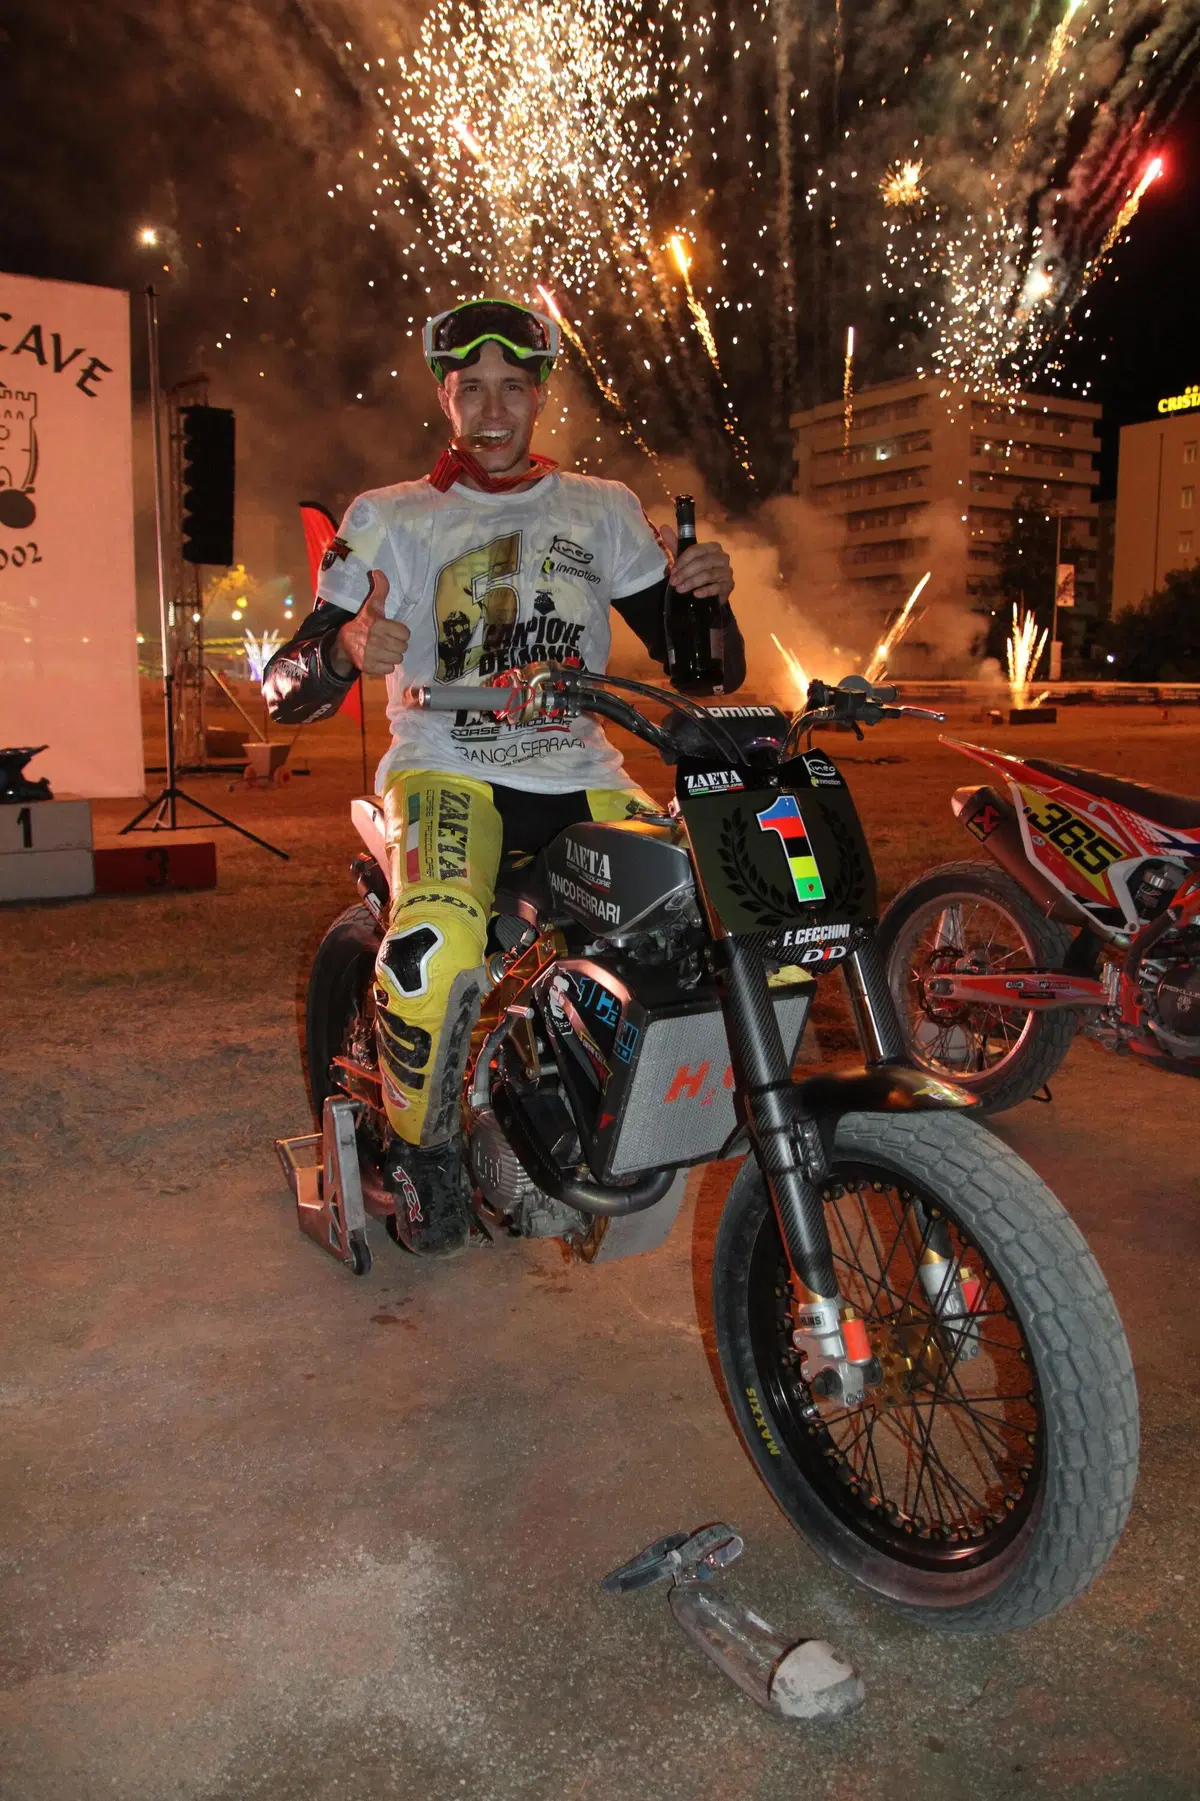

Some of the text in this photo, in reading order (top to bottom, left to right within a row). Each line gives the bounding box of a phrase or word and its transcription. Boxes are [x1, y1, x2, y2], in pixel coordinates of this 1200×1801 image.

[556, 562, 601, 584] inmotion
[684, 770, 742, 789] ZAETA
[16, 807, 33, 848] 1
[437, 789, 471, 880] ZAETA
[756, 795, 827, 903] 1
[1026, 802, 1124, 875] 365
[565, 837, 612, 880] ZAETA
[576, 885, 621, 925] FERRARI
[783, 923, 851, 946] F. CECCHINI
[392, 1165, 424, 1222] TCX
[745, 1387, 781, 1455] MAXXIS
